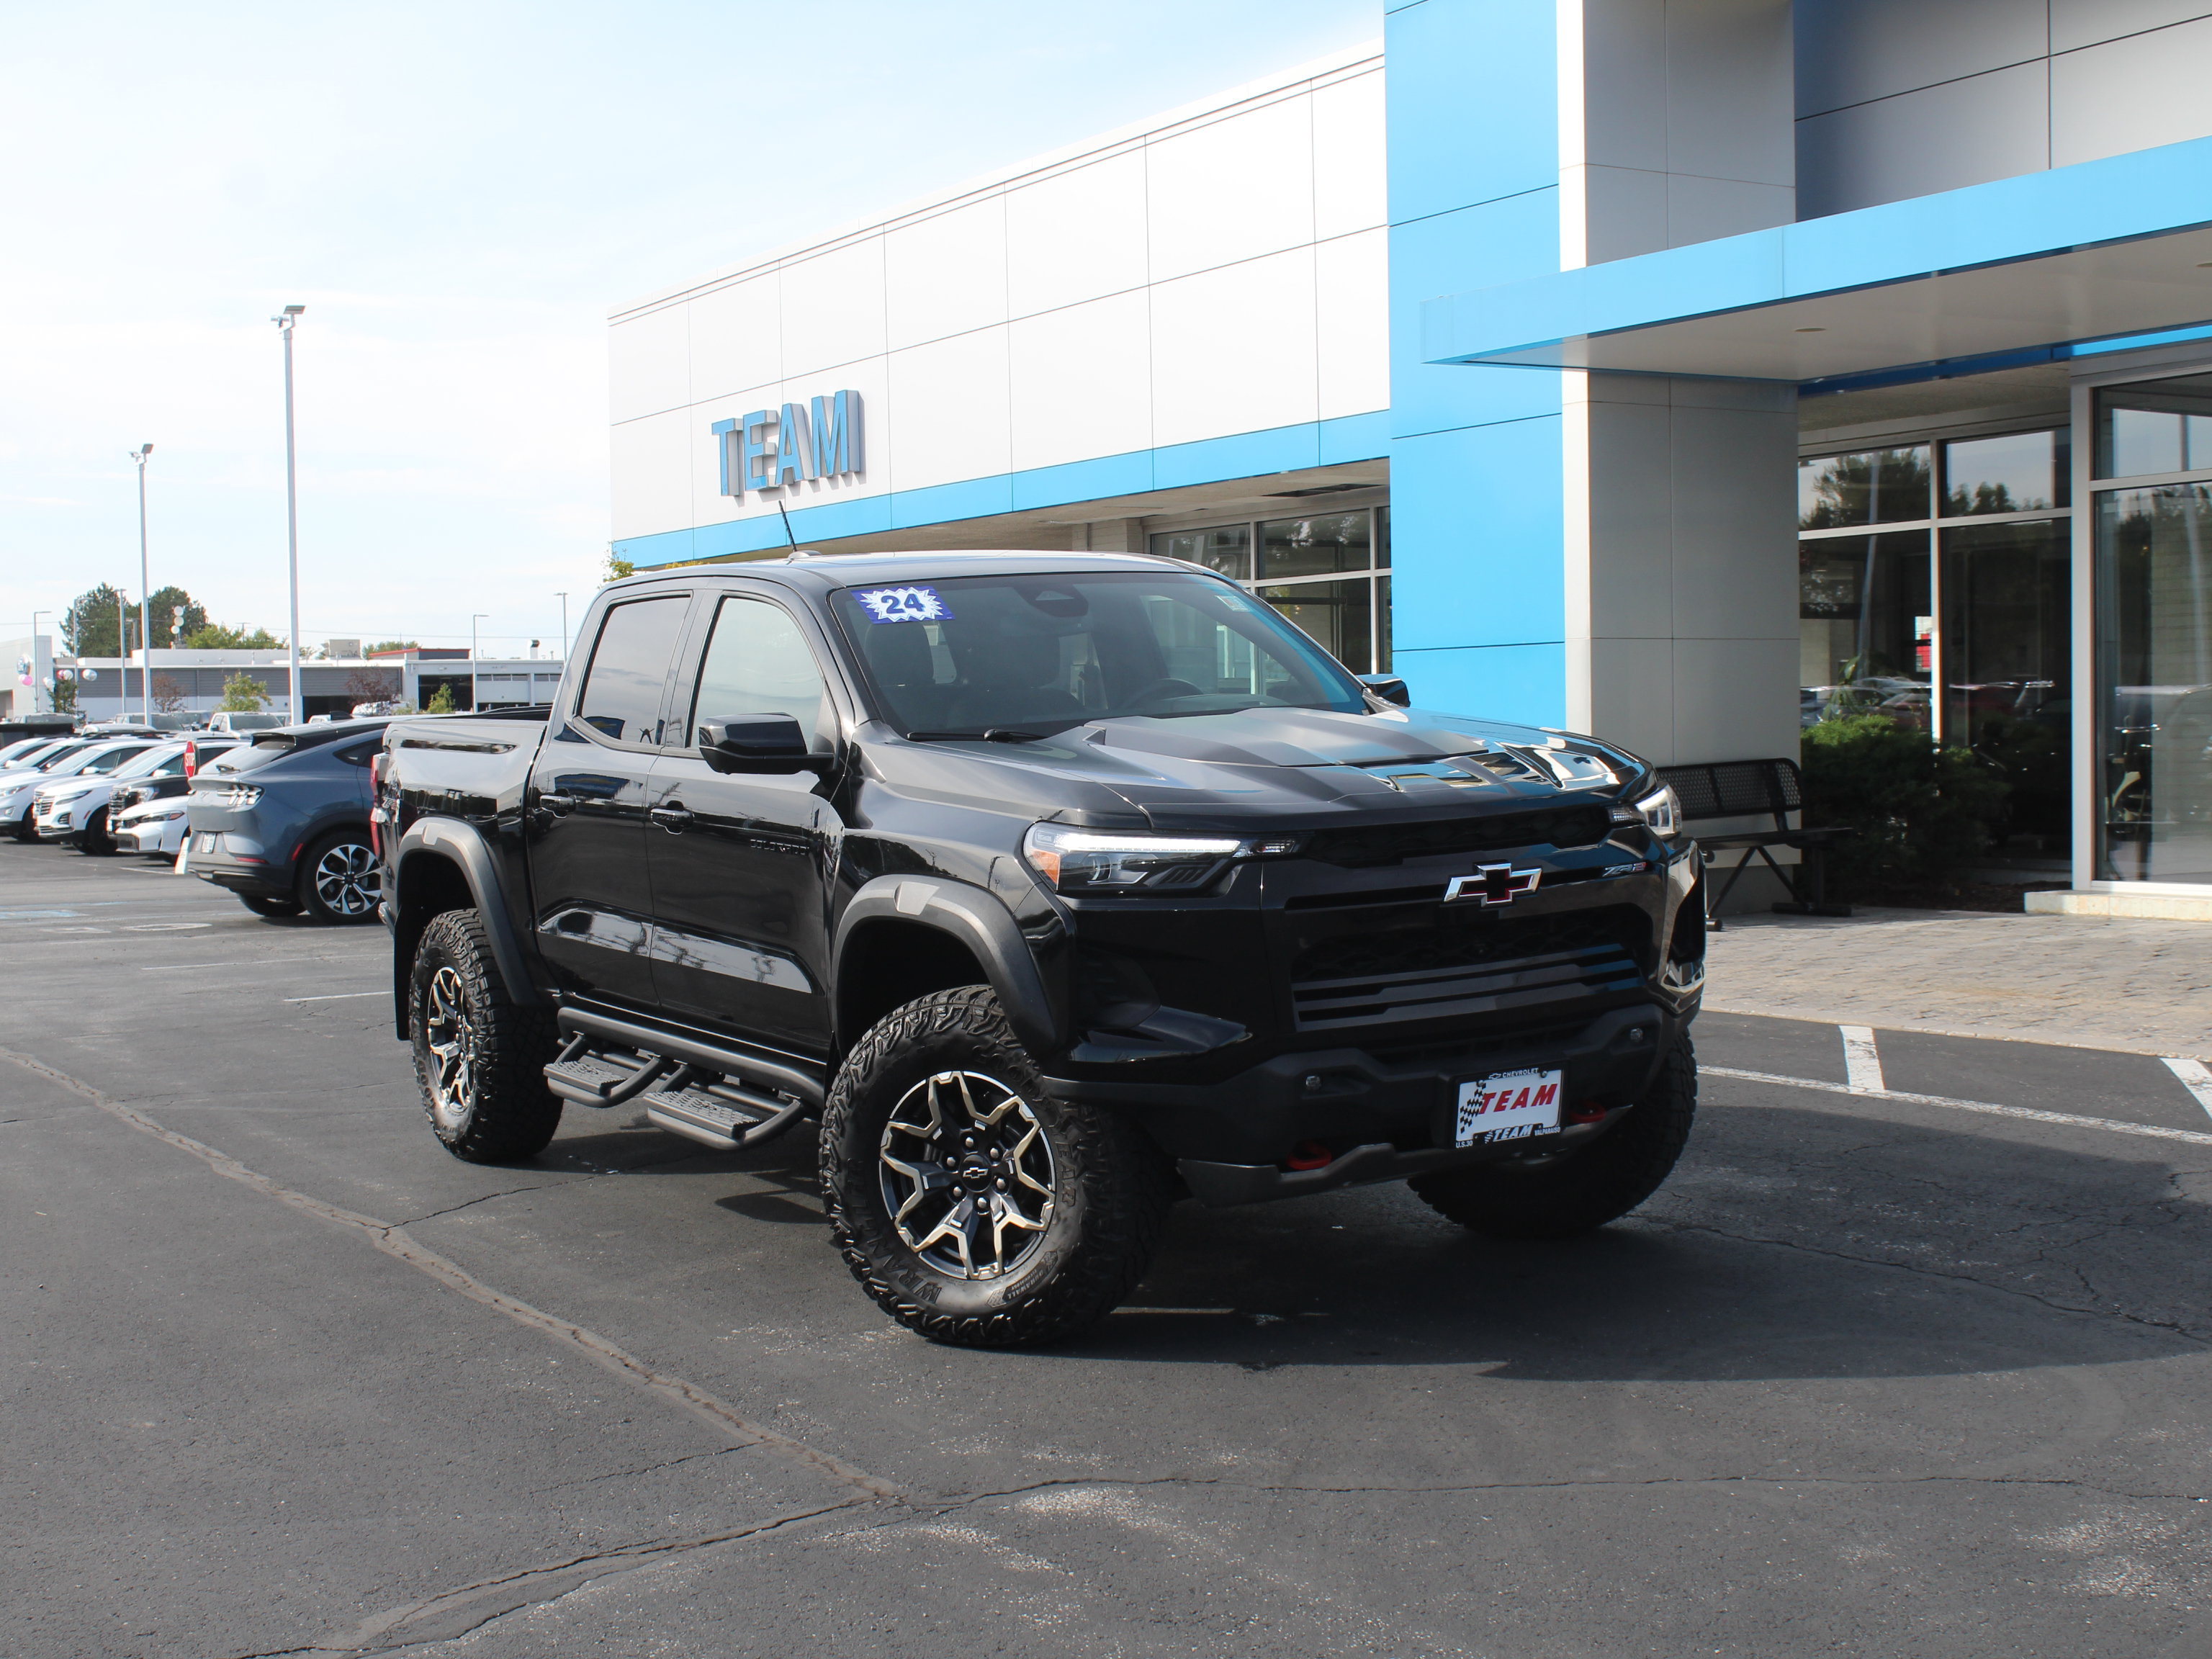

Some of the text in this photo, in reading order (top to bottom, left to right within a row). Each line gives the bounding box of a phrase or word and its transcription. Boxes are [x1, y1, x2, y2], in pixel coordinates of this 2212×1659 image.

[711, 390, 858, 496] TEAM
[881, 593, 925, 614] 24
[185, 752, 195, 767] STOP
[1602, 861, 1647, 877] ZR2
[1502, 1068, 1539, 1079] CHEVROLET
[1479, 1083, 1558, 1115] TEAM
[1493, 1124, 1534, 1141] TEAM
[1534, 1126, 1561, 1136] VALPARAISO
